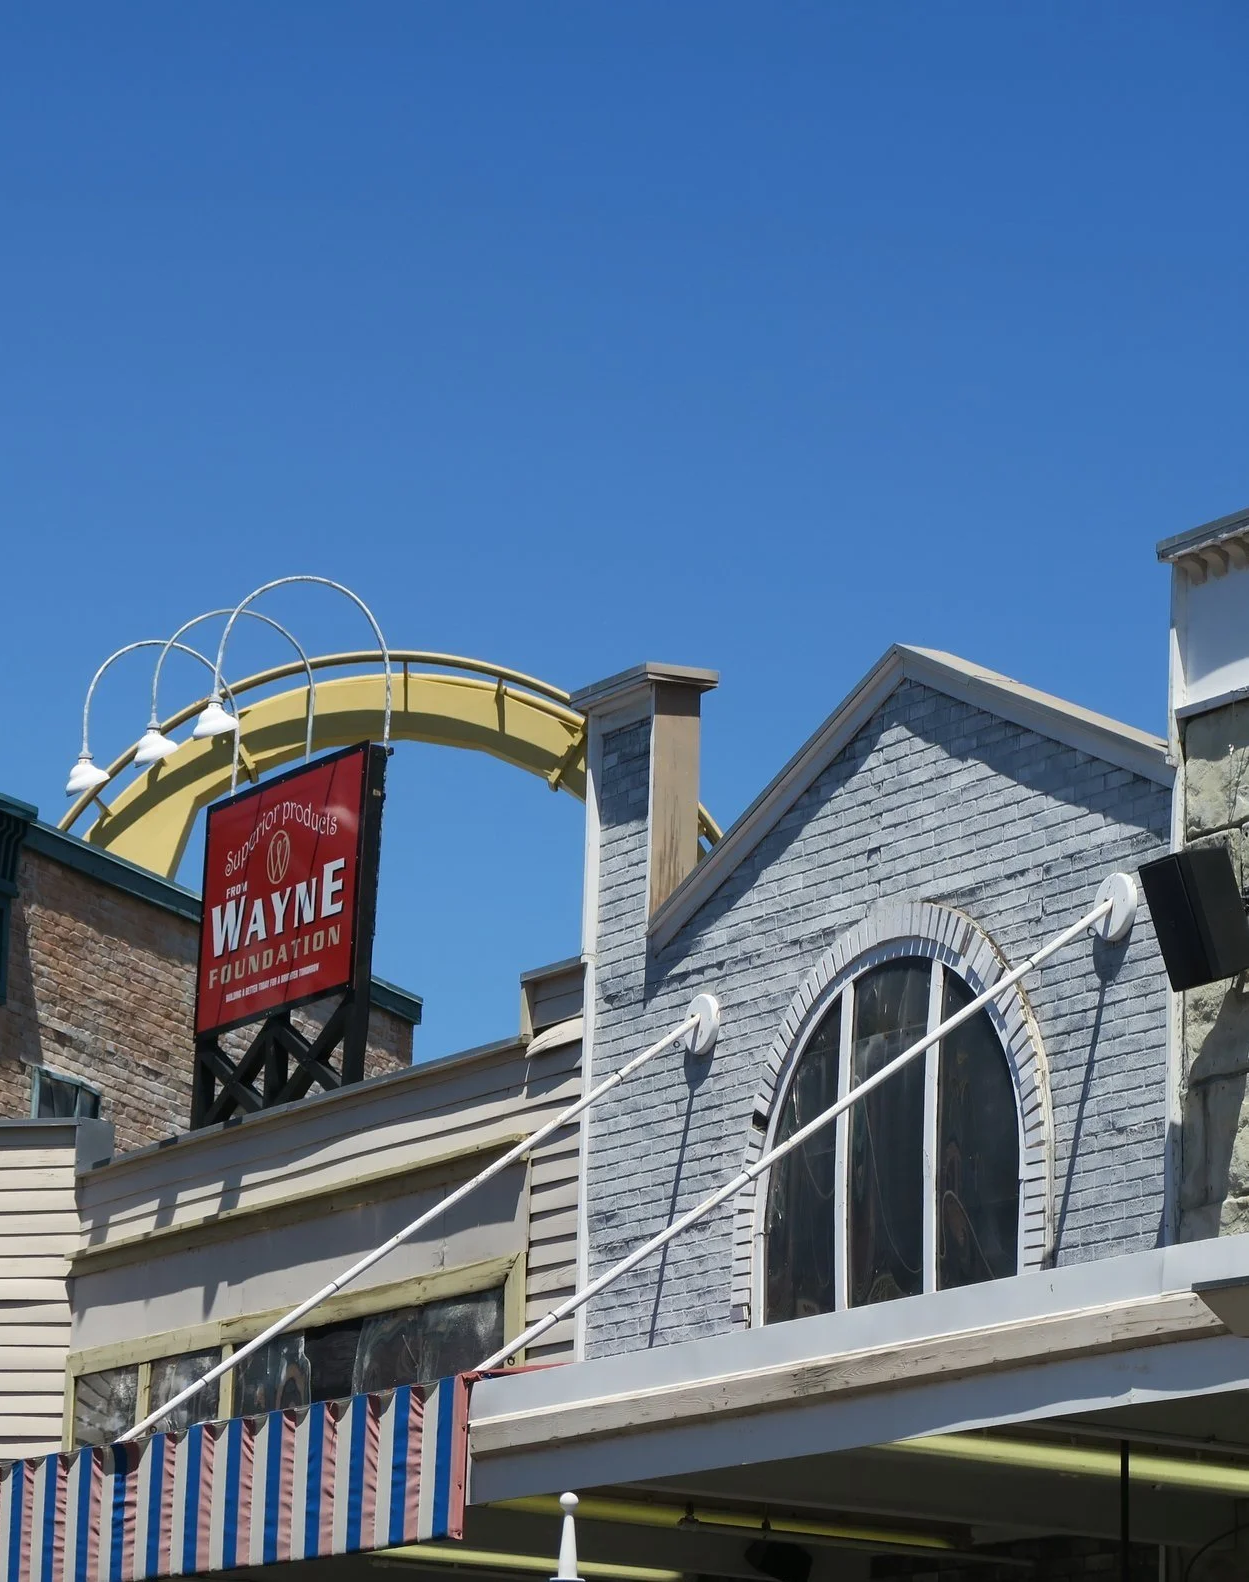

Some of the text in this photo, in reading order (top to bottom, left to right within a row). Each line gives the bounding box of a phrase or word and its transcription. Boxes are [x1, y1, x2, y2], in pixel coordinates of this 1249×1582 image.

[225, 801, 337, 877] Superior products
[211, 857, 346, 958] WAYNE
[226, 881, 248, 899] FROM
[209, 924, 340, 989] FOUNDATION
